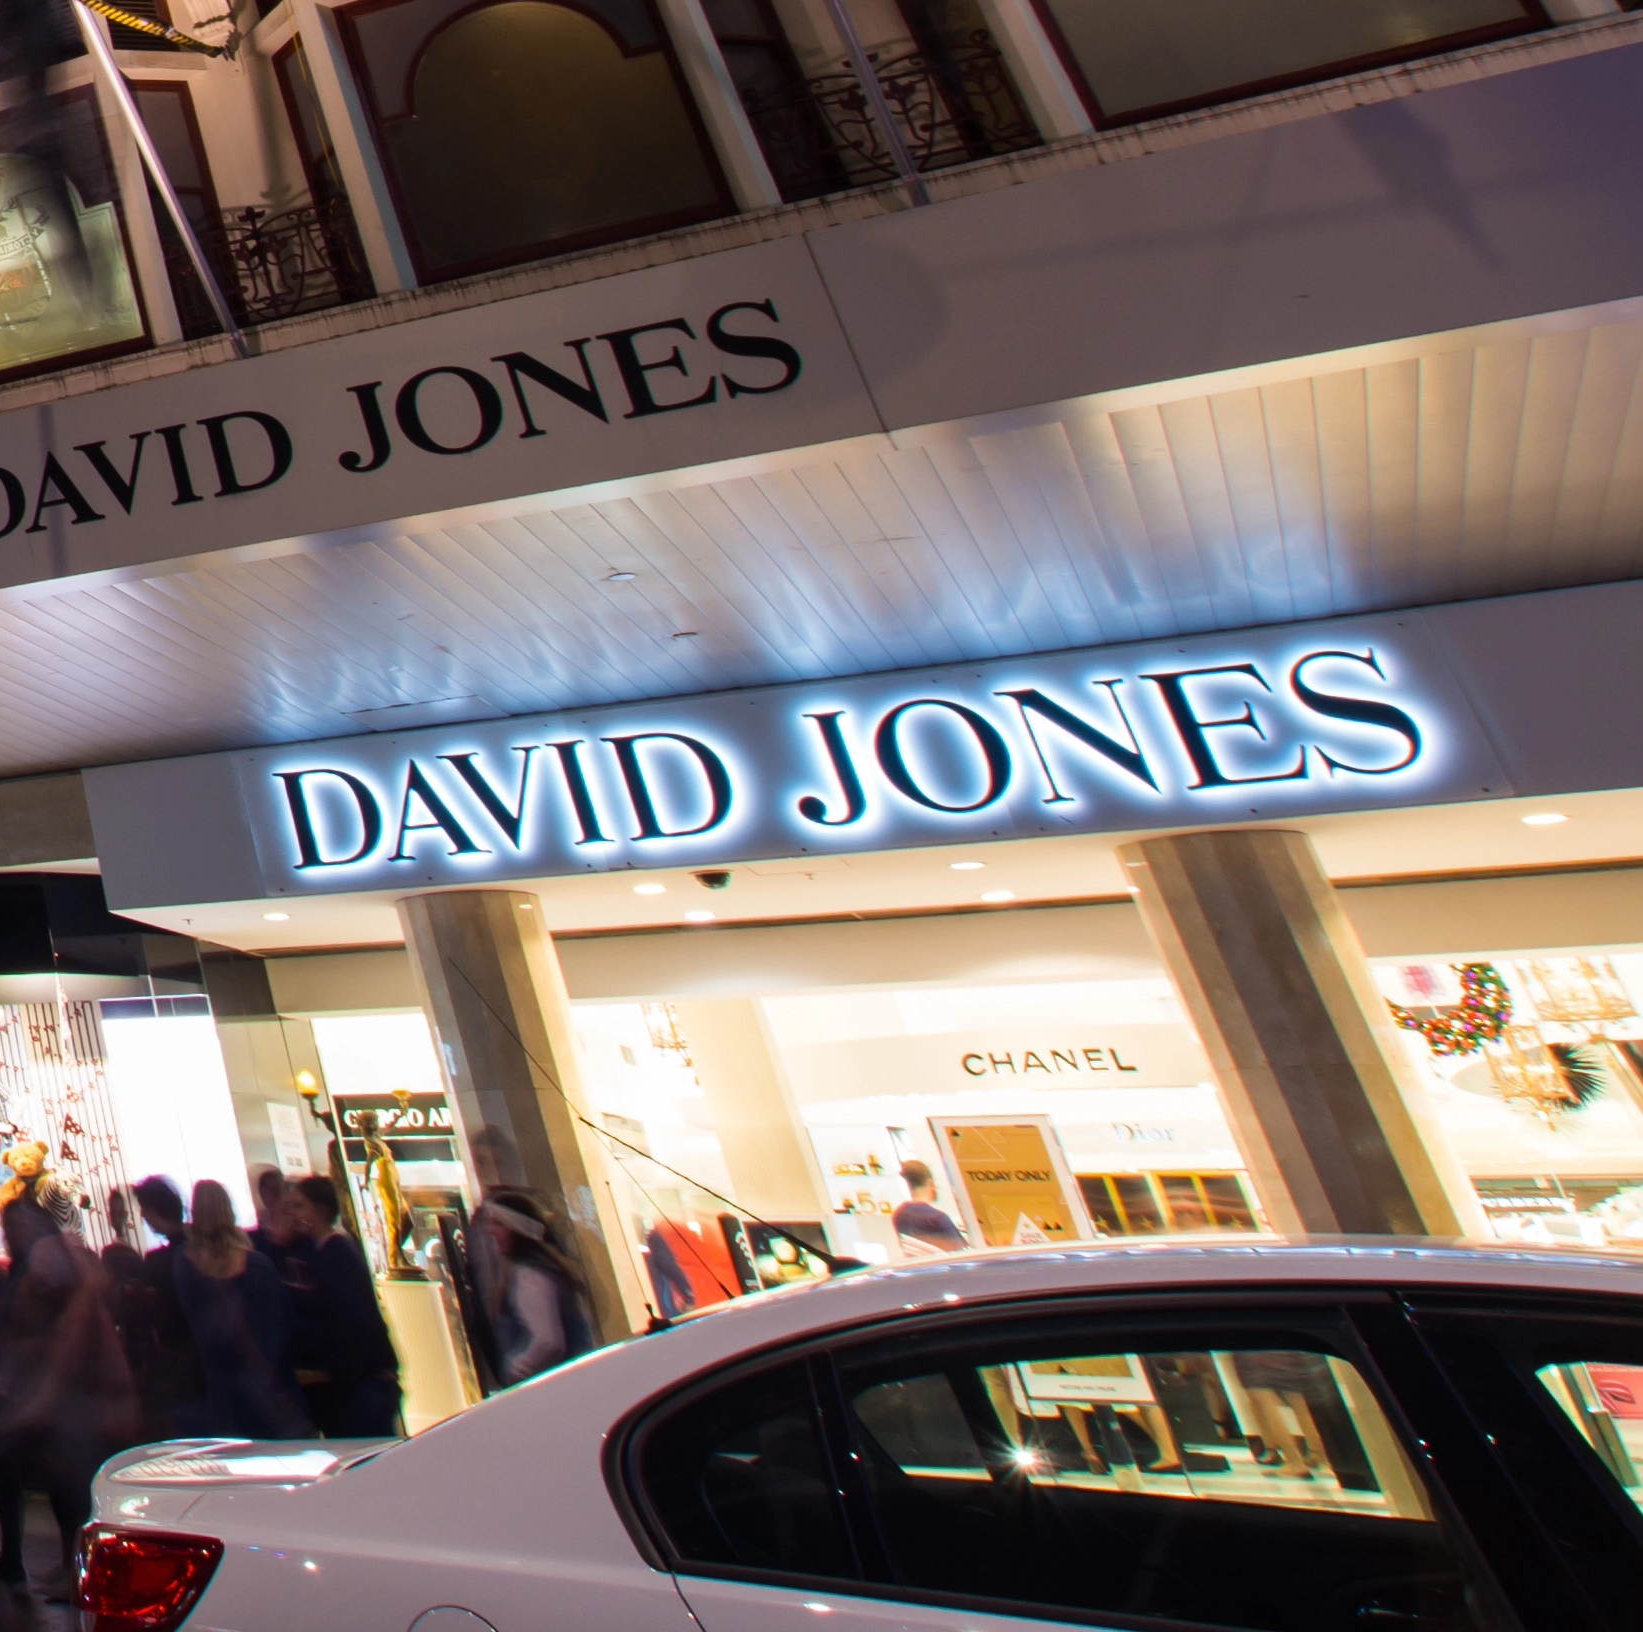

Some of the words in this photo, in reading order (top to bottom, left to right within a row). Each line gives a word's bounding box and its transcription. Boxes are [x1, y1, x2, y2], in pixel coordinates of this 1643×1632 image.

[338, 298, 805, 473] JONES
[272, 730, 737, 871] DAVID
[797, 645, 1425, 828] JONES
[961, 1047, 1139, 1077] CHANEL
[1112, 1123, 1176, 1142] Dior
[967, 1170, 1013, 1182] TODAY
[1015, 1170, 1052, 1182] ONLY
